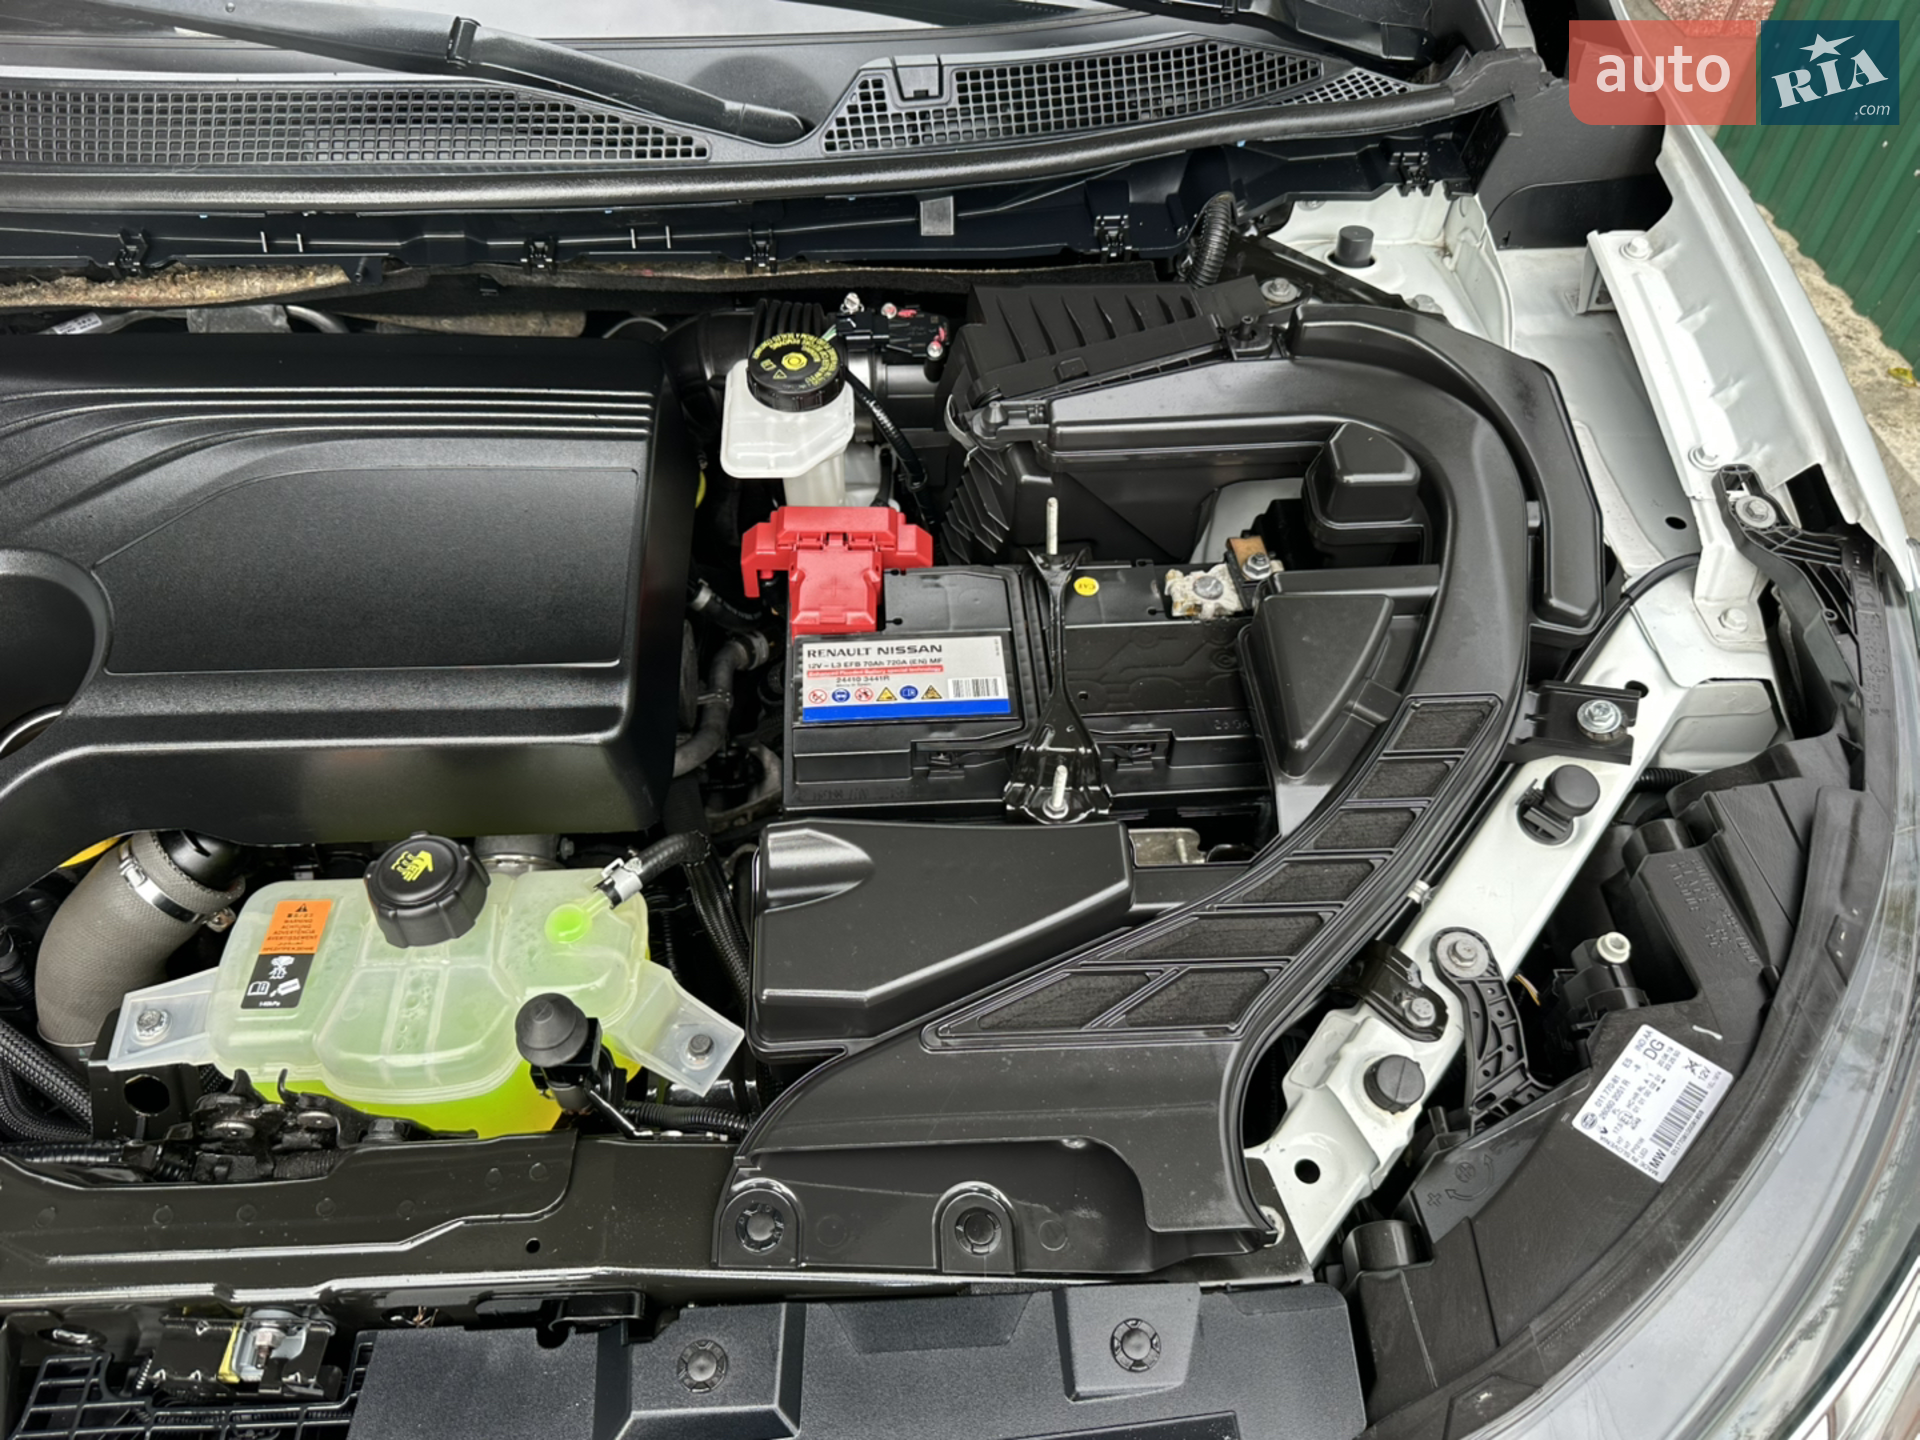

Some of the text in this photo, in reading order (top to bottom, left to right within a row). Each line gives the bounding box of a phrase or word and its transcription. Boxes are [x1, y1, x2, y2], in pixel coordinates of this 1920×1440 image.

[808, 644, 942, 658] RENAULT NISSAN
[1642, 1029, 1652, 1040] AA
[1643, 1039, 1665, 1060] DG
[1697, 1066, 1712, 1081] 12V
[1594, 1094, 1606, 1108] 011
[1622, 1057, 1632, 1067] ES
[1649, 1149, 1666, 1168] MW
